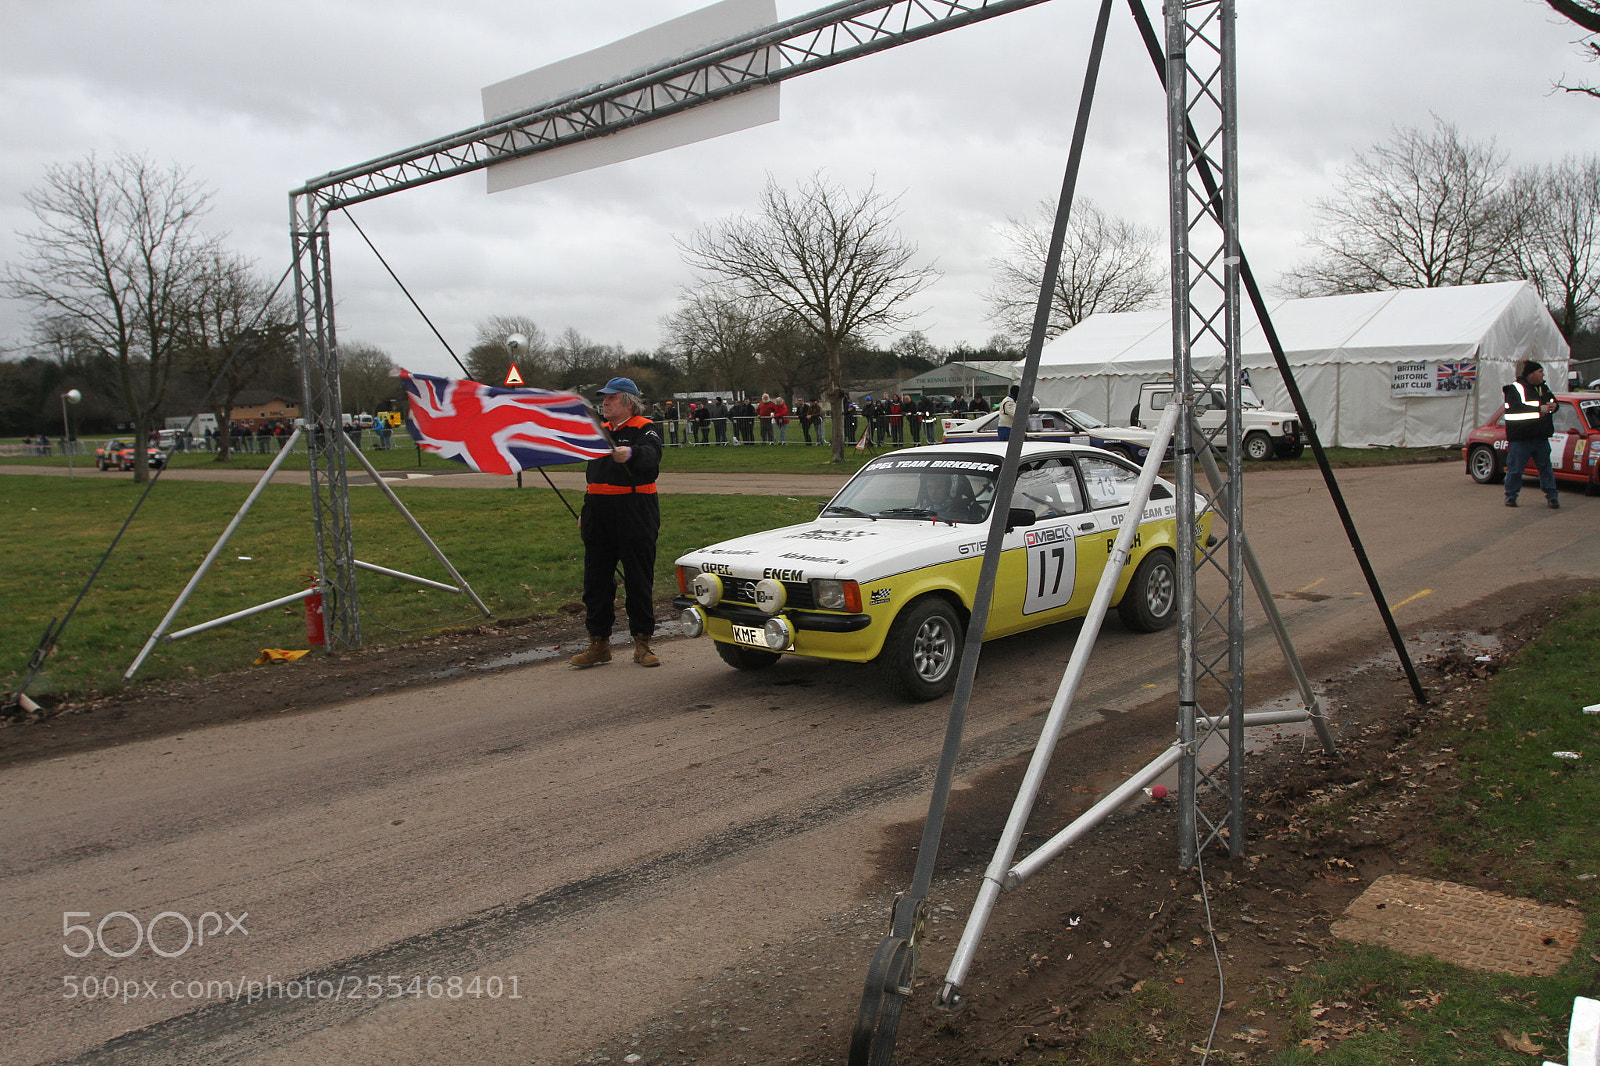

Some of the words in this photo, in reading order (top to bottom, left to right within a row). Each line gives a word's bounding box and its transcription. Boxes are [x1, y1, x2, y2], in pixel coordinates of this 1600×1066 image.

[1397, 364, 1426, 372] BRITISH
[1394, 373, 1428, 381] HISTORIC
[1391, 382, 1409, 390] KART
[1410, 381, 1432, 389] CLUB
[1493, 440, 1509, 450] elf
[866, 463, 894, 472] OPEL
[895, 460, 929, 469] TEAM
[930, 460, 1000, 473] BIRKBECK
[1098, 476, 1117, 497] 13
[701, 563, 733, 576] OPEL
[763, 568, 804, 582] ENEM
[1037, 547, 1065, 598] 17
[734, 627, 757, 644] KMF
